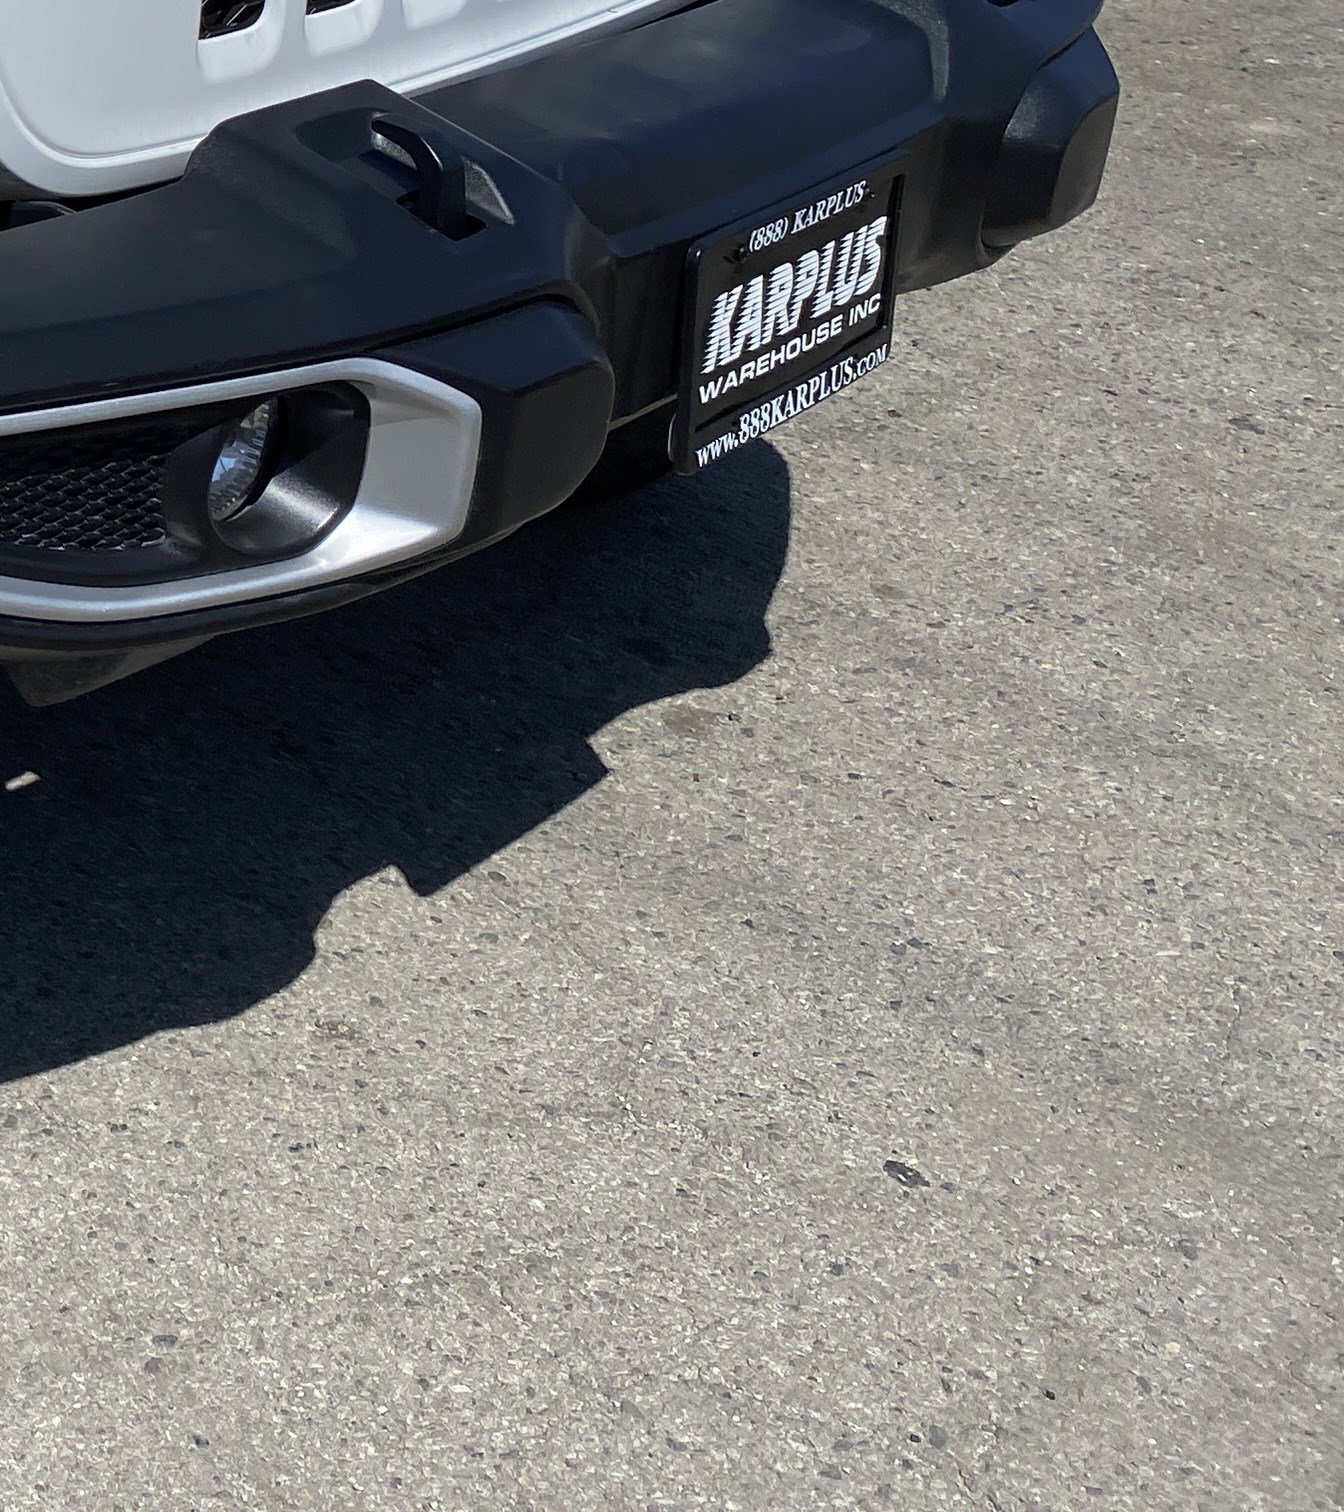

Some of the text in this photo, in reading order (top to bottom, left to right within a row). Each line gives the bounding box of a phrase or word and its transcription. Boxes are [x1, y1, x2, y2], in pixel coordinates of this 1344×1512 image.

[748, 179, 867, 253] (888) KARPLUS
[699, 293, 881, 405] WAREHOUSE INC
[701, 215, 888, 375] KARPLUS
